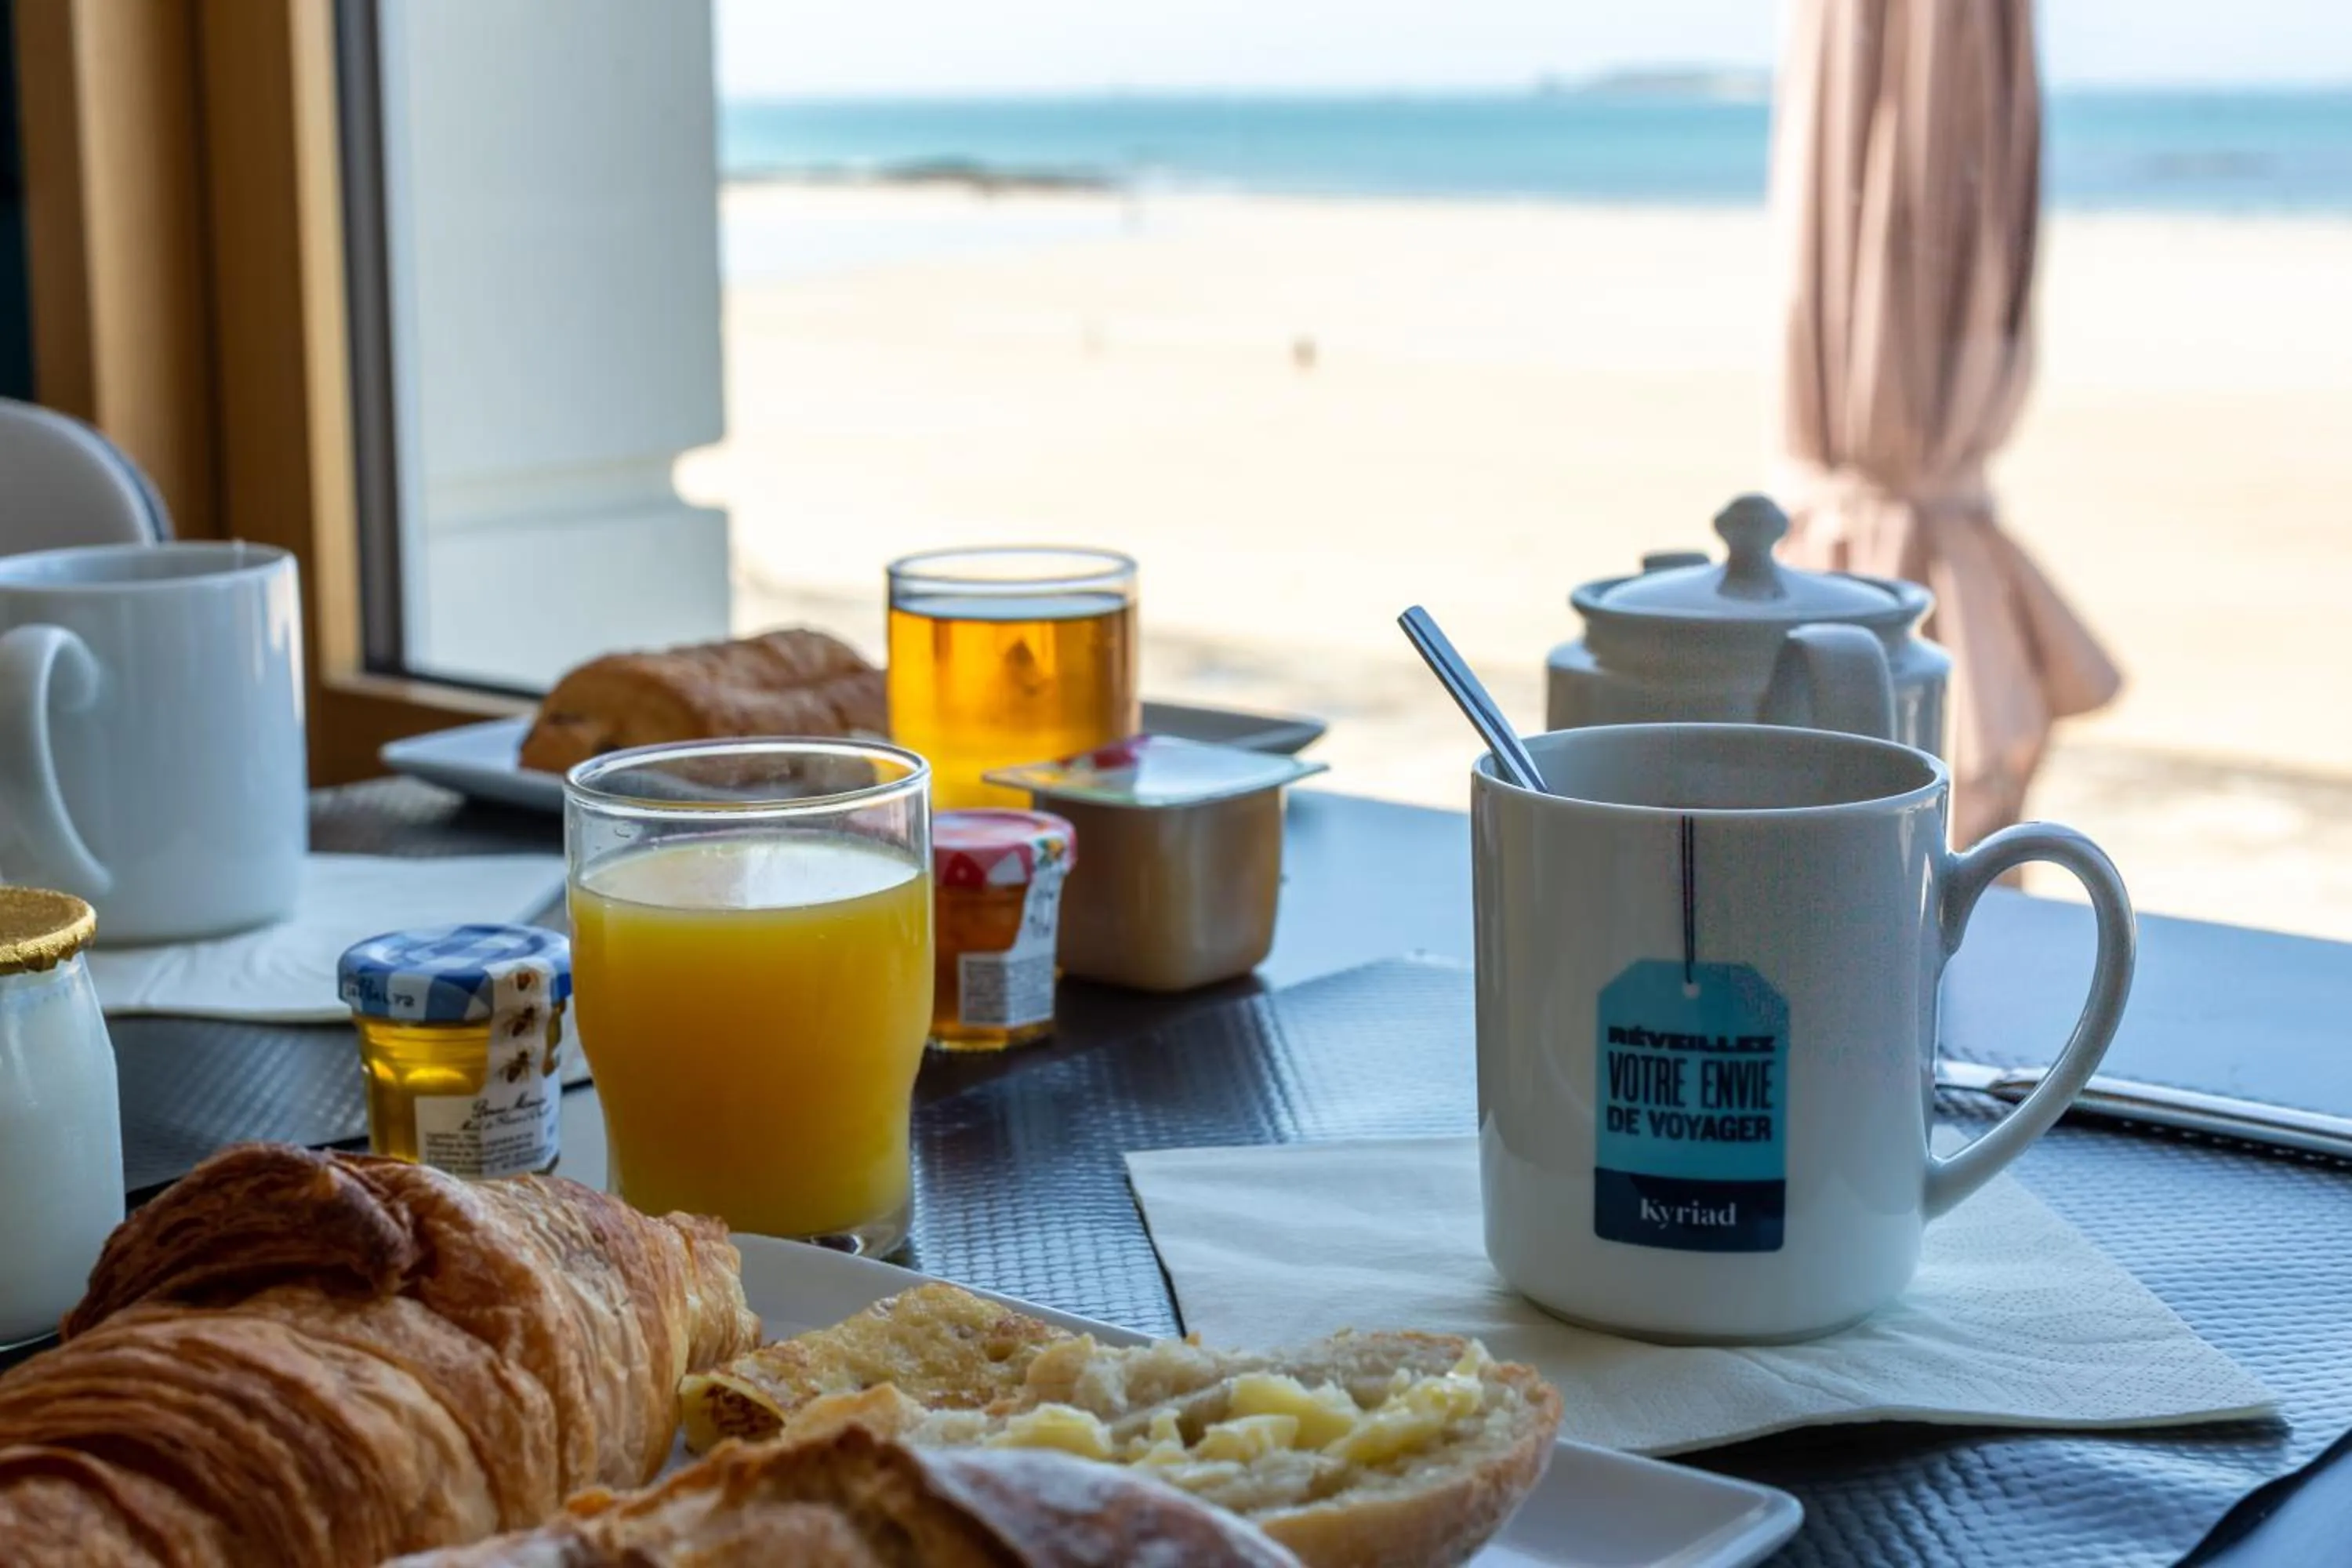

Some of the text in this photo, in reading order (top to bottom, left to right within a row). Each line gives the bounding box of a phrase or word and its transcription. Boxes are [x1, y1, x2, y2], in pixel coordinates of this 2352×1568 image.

[1607, 1050, 1776, 1110] VOTRE ENVIE
[1606, 1104, 1772, 1142] DE VOYAGER
[1639, 1196, 1737, 1230] Kyriad
